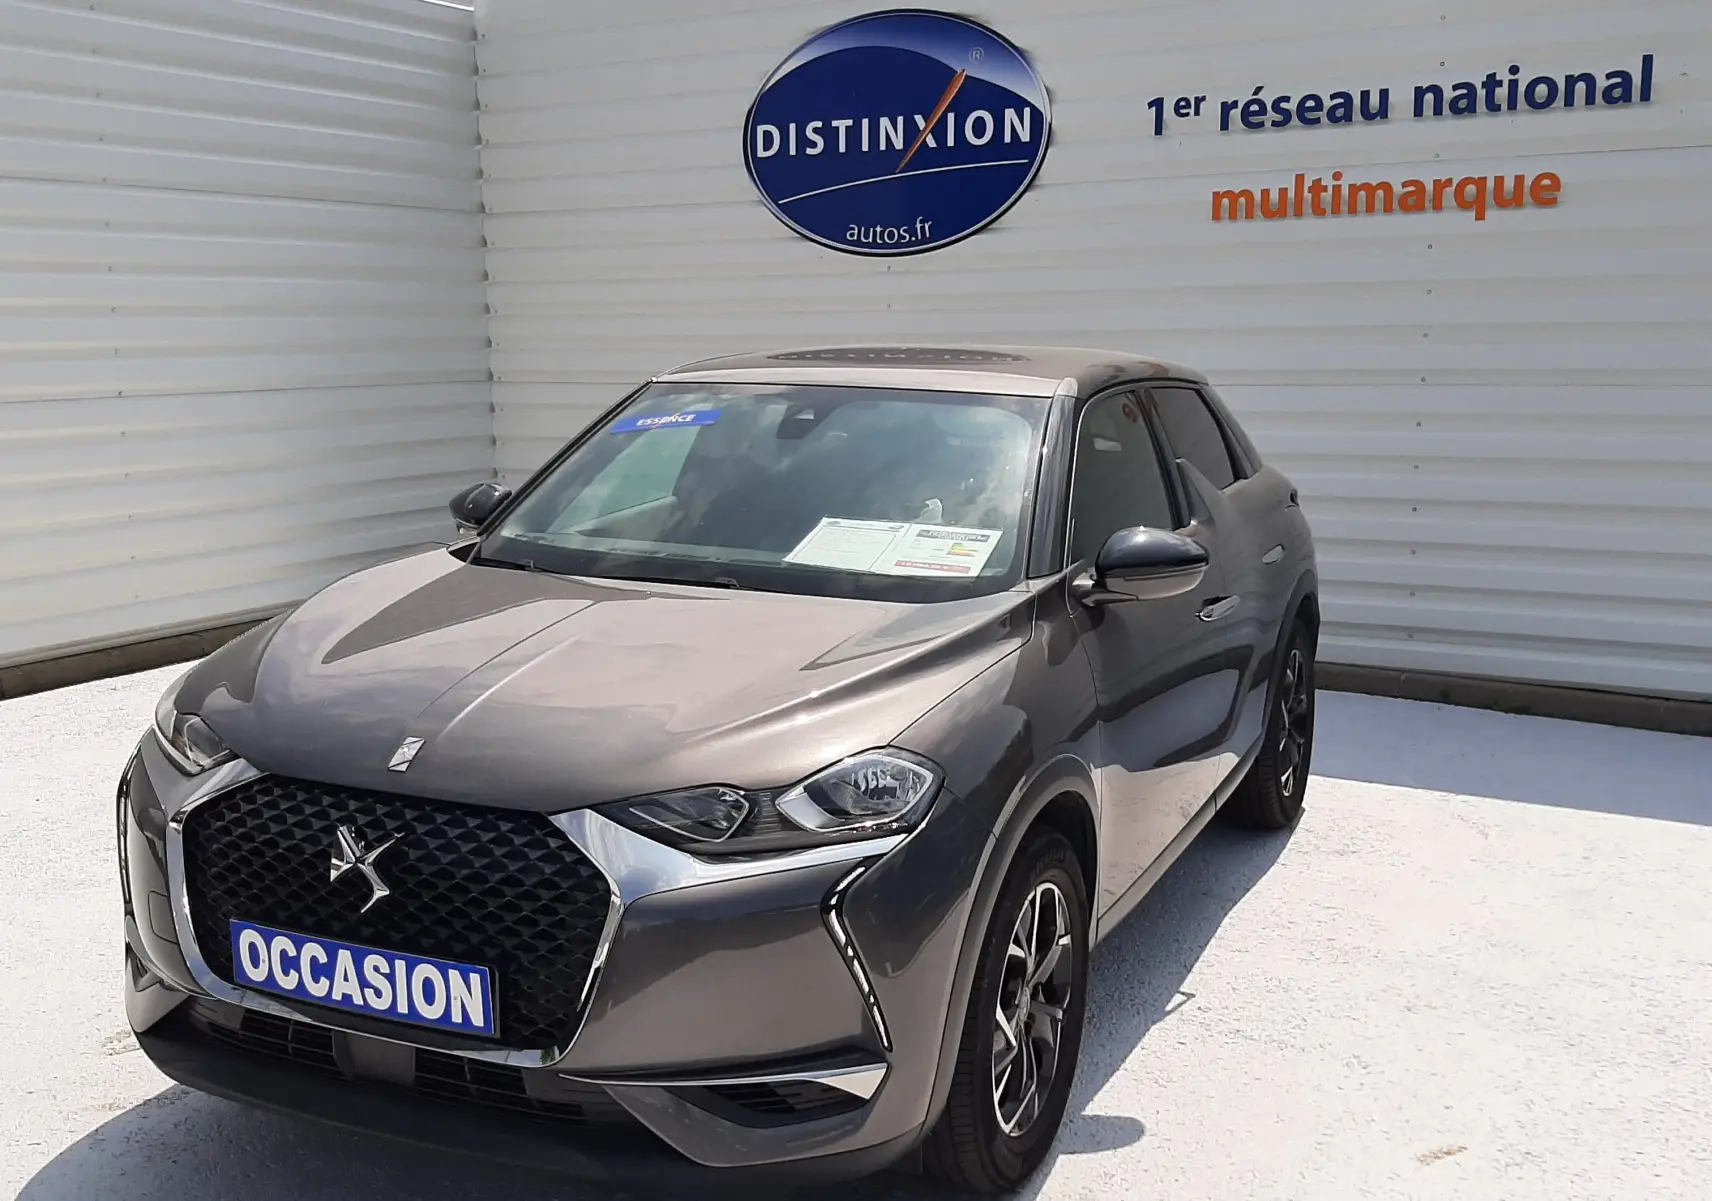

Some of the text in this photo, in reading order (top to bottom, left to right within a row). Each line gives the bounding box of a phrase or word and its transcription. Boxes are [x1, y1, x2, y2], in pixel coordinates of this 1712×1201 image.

[1146, 53, 1654, 136] 1er réseau national
[756, 106, 1031, 159] DISTINXION
[1210, 170, 1561, 221] multimarque
[846, 216, 932, 243] autos.fr
[636, 413, 696, 426] ESSENCE
[239, 928, 484, 1028] OCCASION
